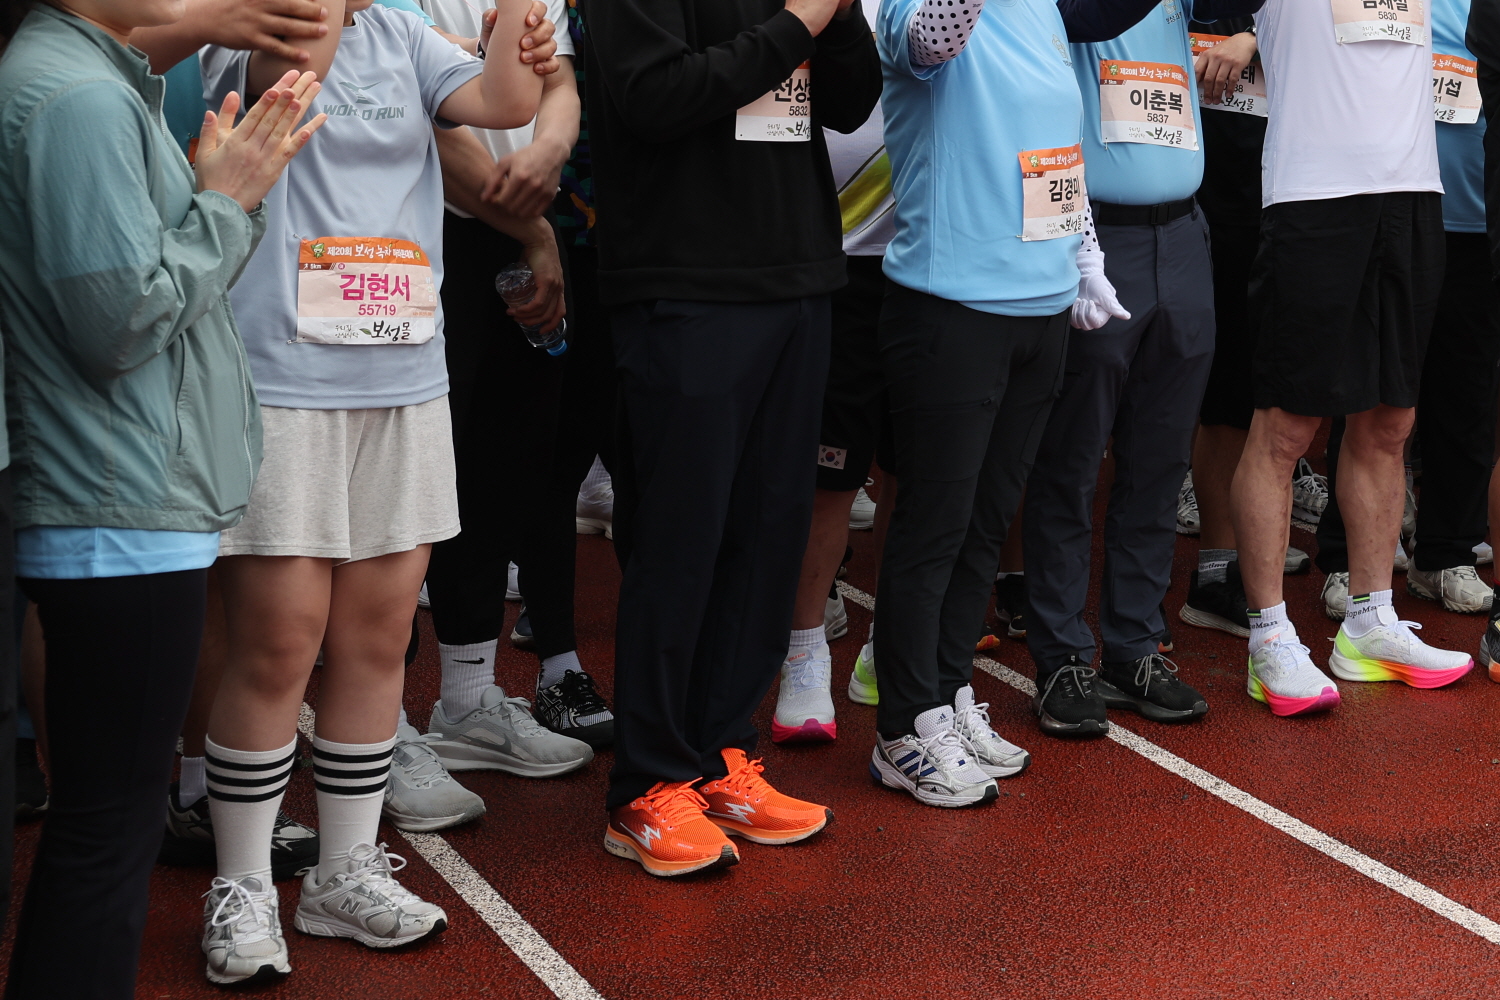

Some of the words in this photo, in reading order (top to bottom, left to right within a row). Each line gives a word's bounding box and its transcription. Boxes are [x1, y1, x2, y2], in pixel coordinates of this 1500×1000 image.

[1378, 11, 1397, 21] 5830
[1387, 23, 1411, 40] 보성몰
[1139, 67, 1154, 79] 보성
[1130, 89, 1183, 115] 이춘복
[789, 106, 808, 116] 5832
[1147, 113, 1169, 124] 5837
[1154, 127, 1183, 145] 보성몰
[1049, 175, 1080, 202] 김경미
[327, 246, 352, 256] 제20회
[354, 244, 374, 259] 보성
[376, 244, 392, 259] 녹차
[339, 273, 410, 301] 김현서
[358, 304, 396, 316] 55719
[371, 320, 412, 342] 보성몰
